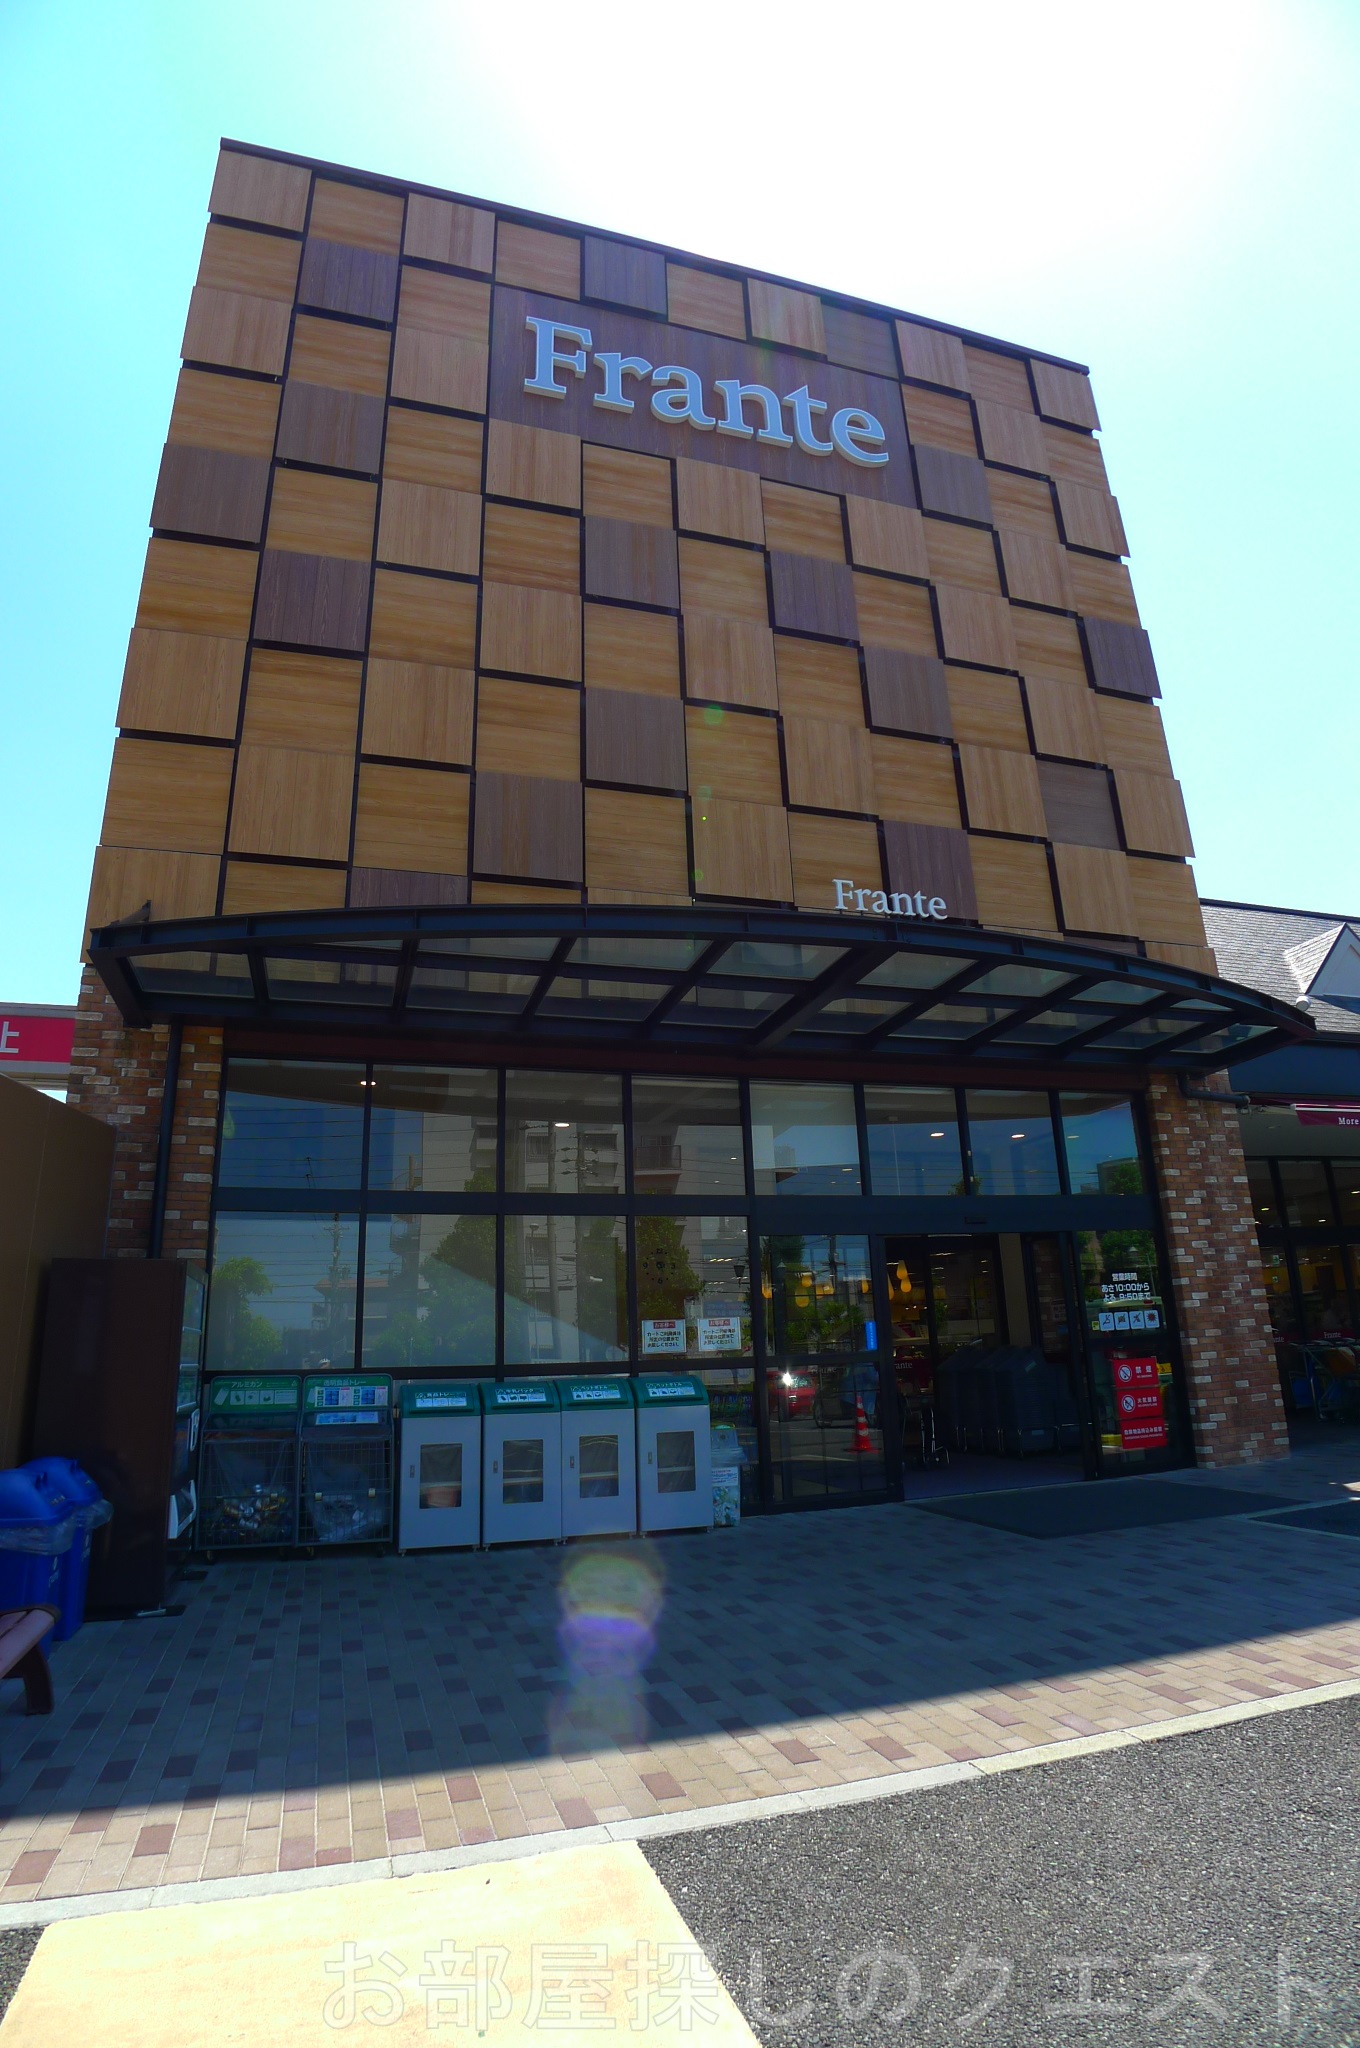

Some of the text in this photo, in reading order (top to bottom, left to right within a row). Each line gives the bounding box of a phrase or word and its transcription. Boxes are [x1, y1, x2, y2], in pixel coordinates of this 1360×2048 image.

[524, 316, 889, 468] Frante
[832, 878, 948, 920] Frante
[1338, 1116, 1360, 1125] More
[1101, 1282, 1150, 1293] あさ10:00から
